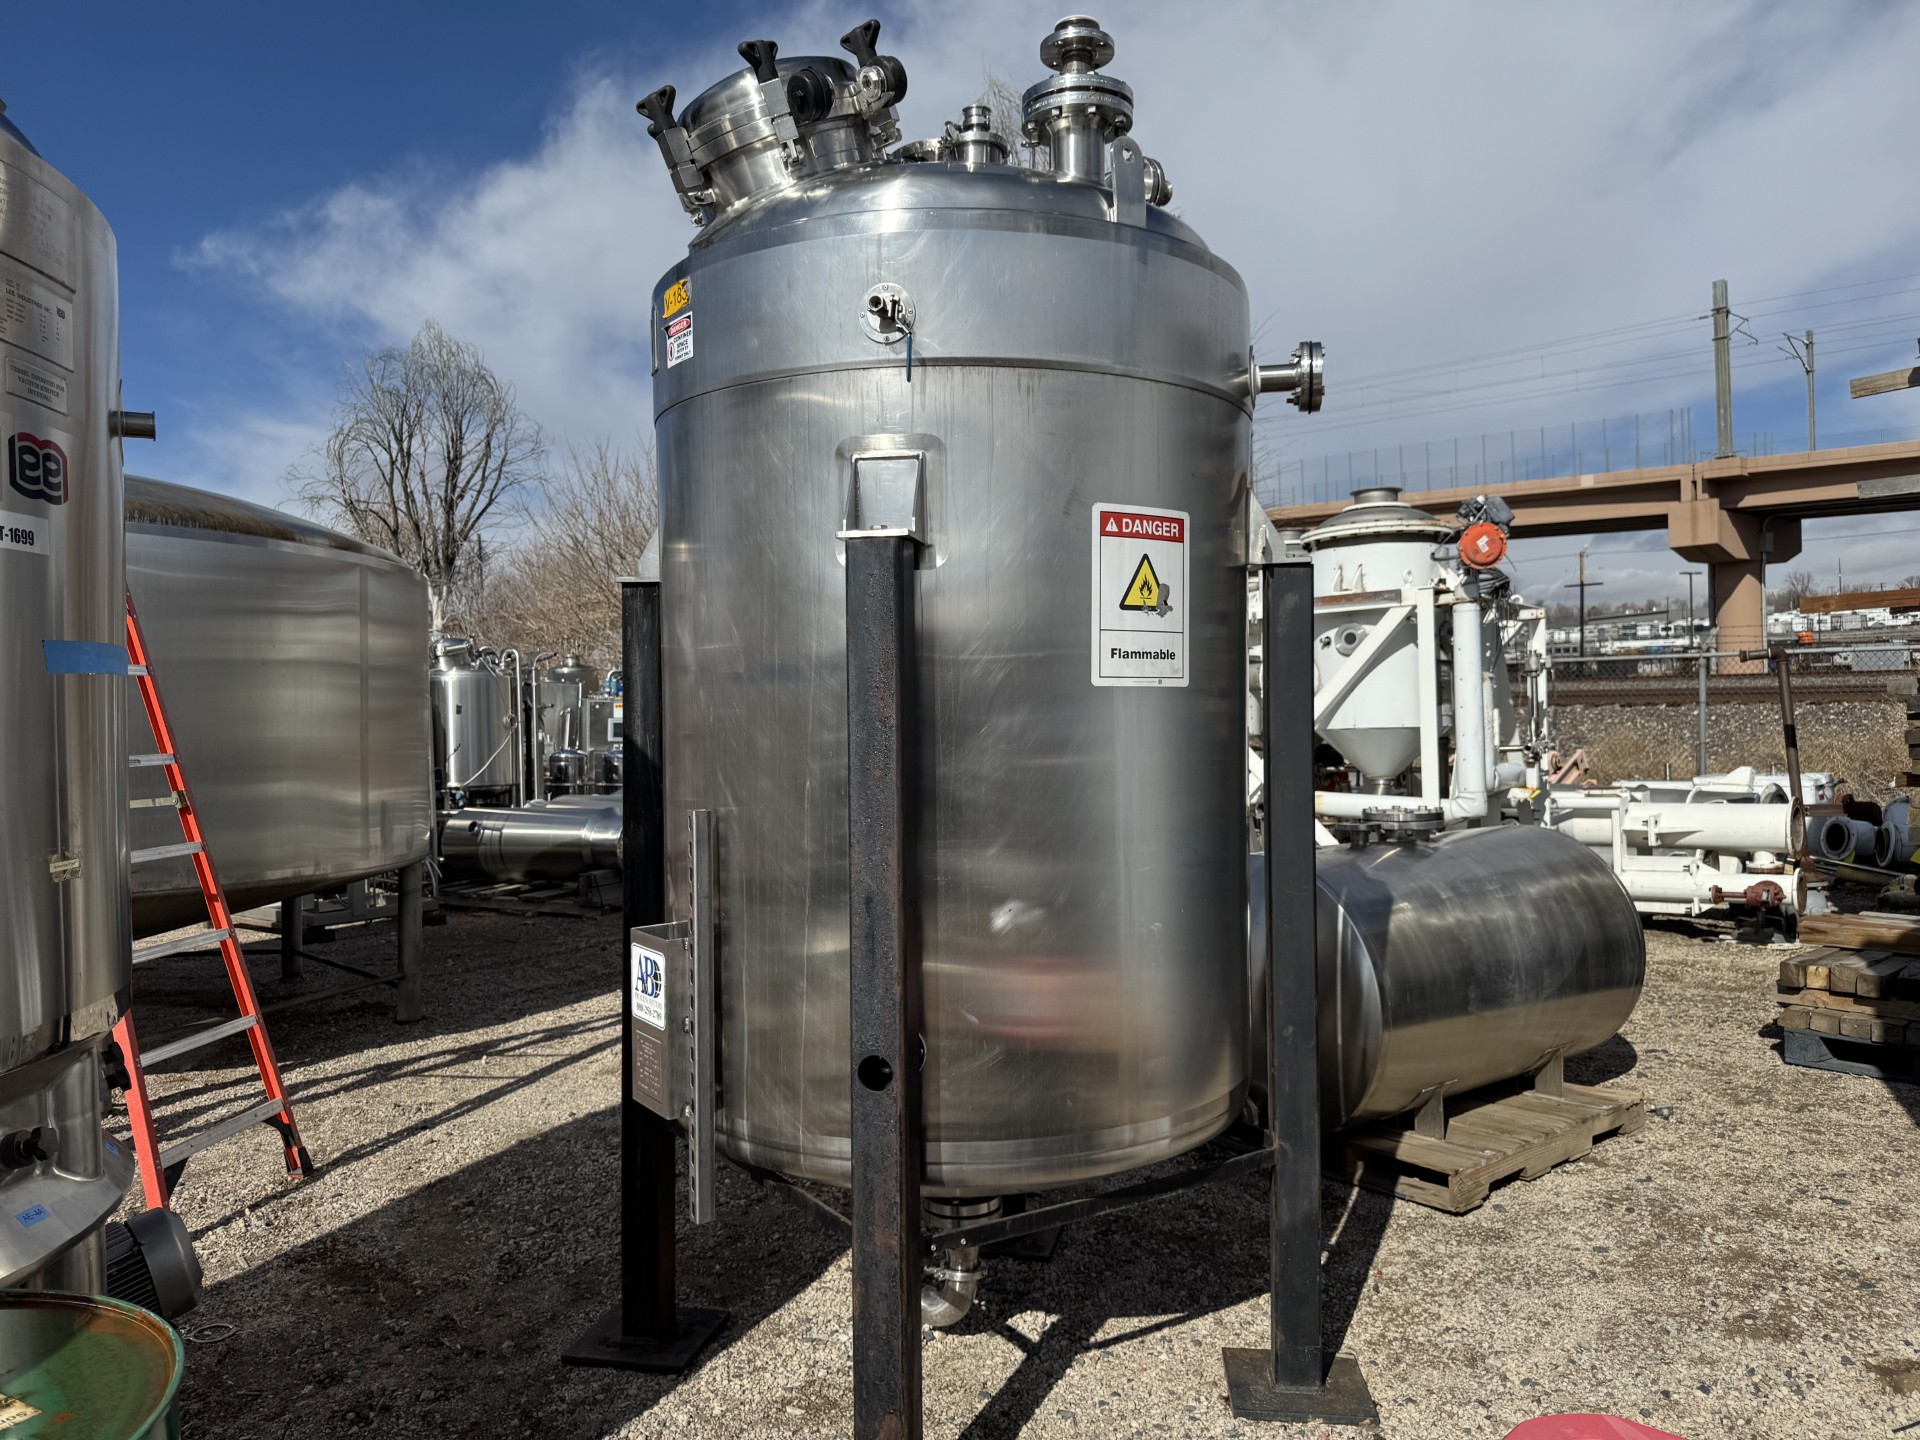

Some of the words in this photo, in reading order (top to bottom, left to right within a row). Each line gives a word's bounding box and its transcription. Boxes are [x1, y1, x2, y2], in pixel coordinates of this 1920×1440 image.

[671, 320, 688, 335] DANGER
[674, 330, 691, 343] CONFINED
[677, 339, 688, 349] SPACE
[1122, 518, 1179, 538] DANGER
[0, 525, 34, 546] T-1699
[1110, 647, 1176, 660] Flammable
